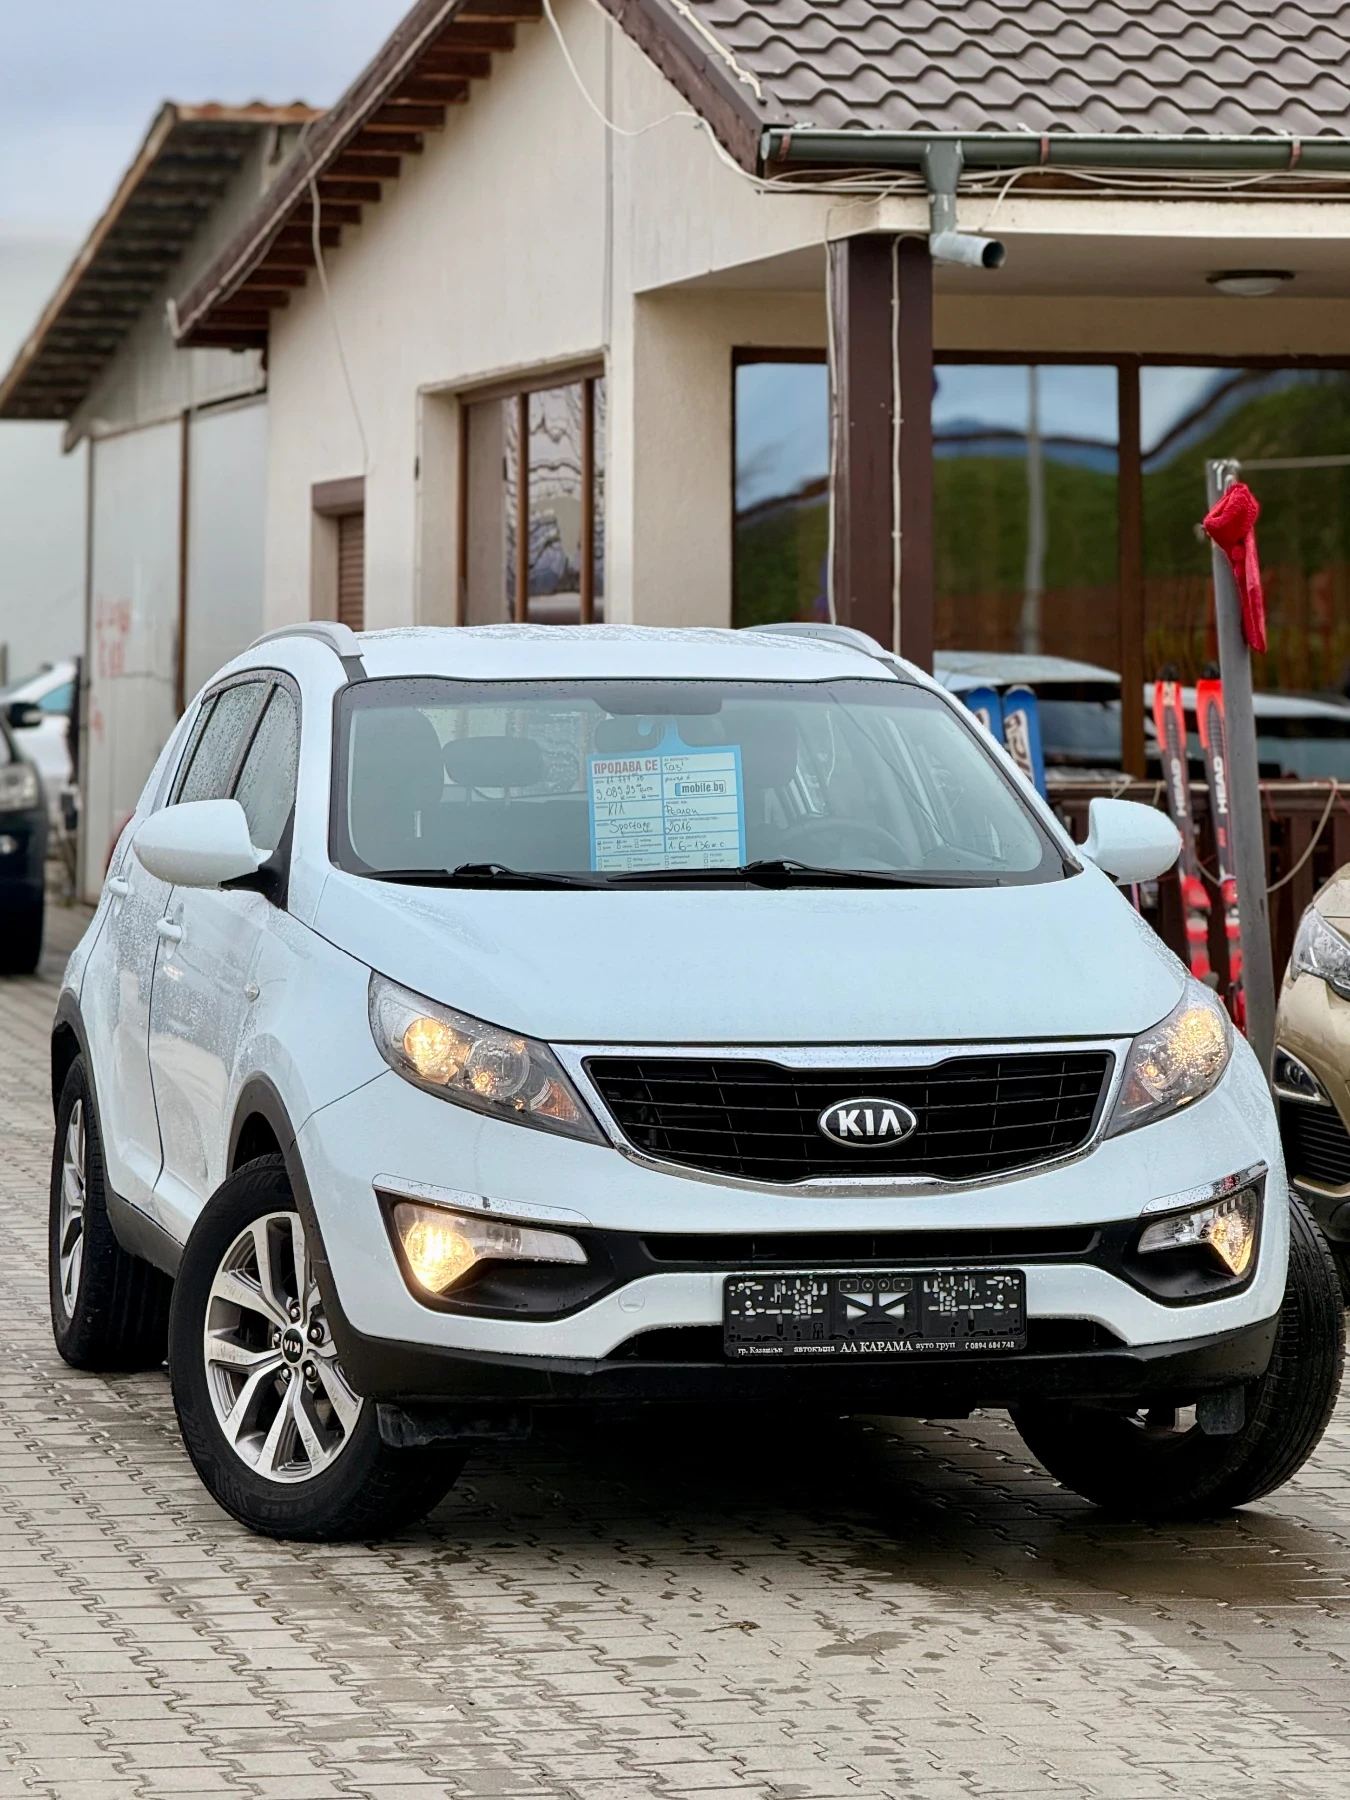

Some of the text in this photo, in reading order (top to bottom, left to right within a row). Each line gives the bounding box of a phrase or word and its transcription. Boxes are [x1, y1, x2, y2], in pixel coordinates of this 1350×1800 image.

[594, 759, 658, 775] ПРОДАВА СЕ
[682, 781, 724, 793] mobile.bg
[1171, 757, 1187, 817] HEAD
[1213, 755, 1228, 814] HEAD
[665, 820, 692, 834] 2016
[837, 1109, 902, 1136] KIA
[284, 1339, 301, 1354] KIA
[794, 1345, 835, 1353] автокъща
[840, 1342, 858, 1353] АЛ
[860, 1341, 913, 1353] КАРАМА
[916, 1342, 934, 1351] ауто
[936, 1342, 955, 1351] груп
